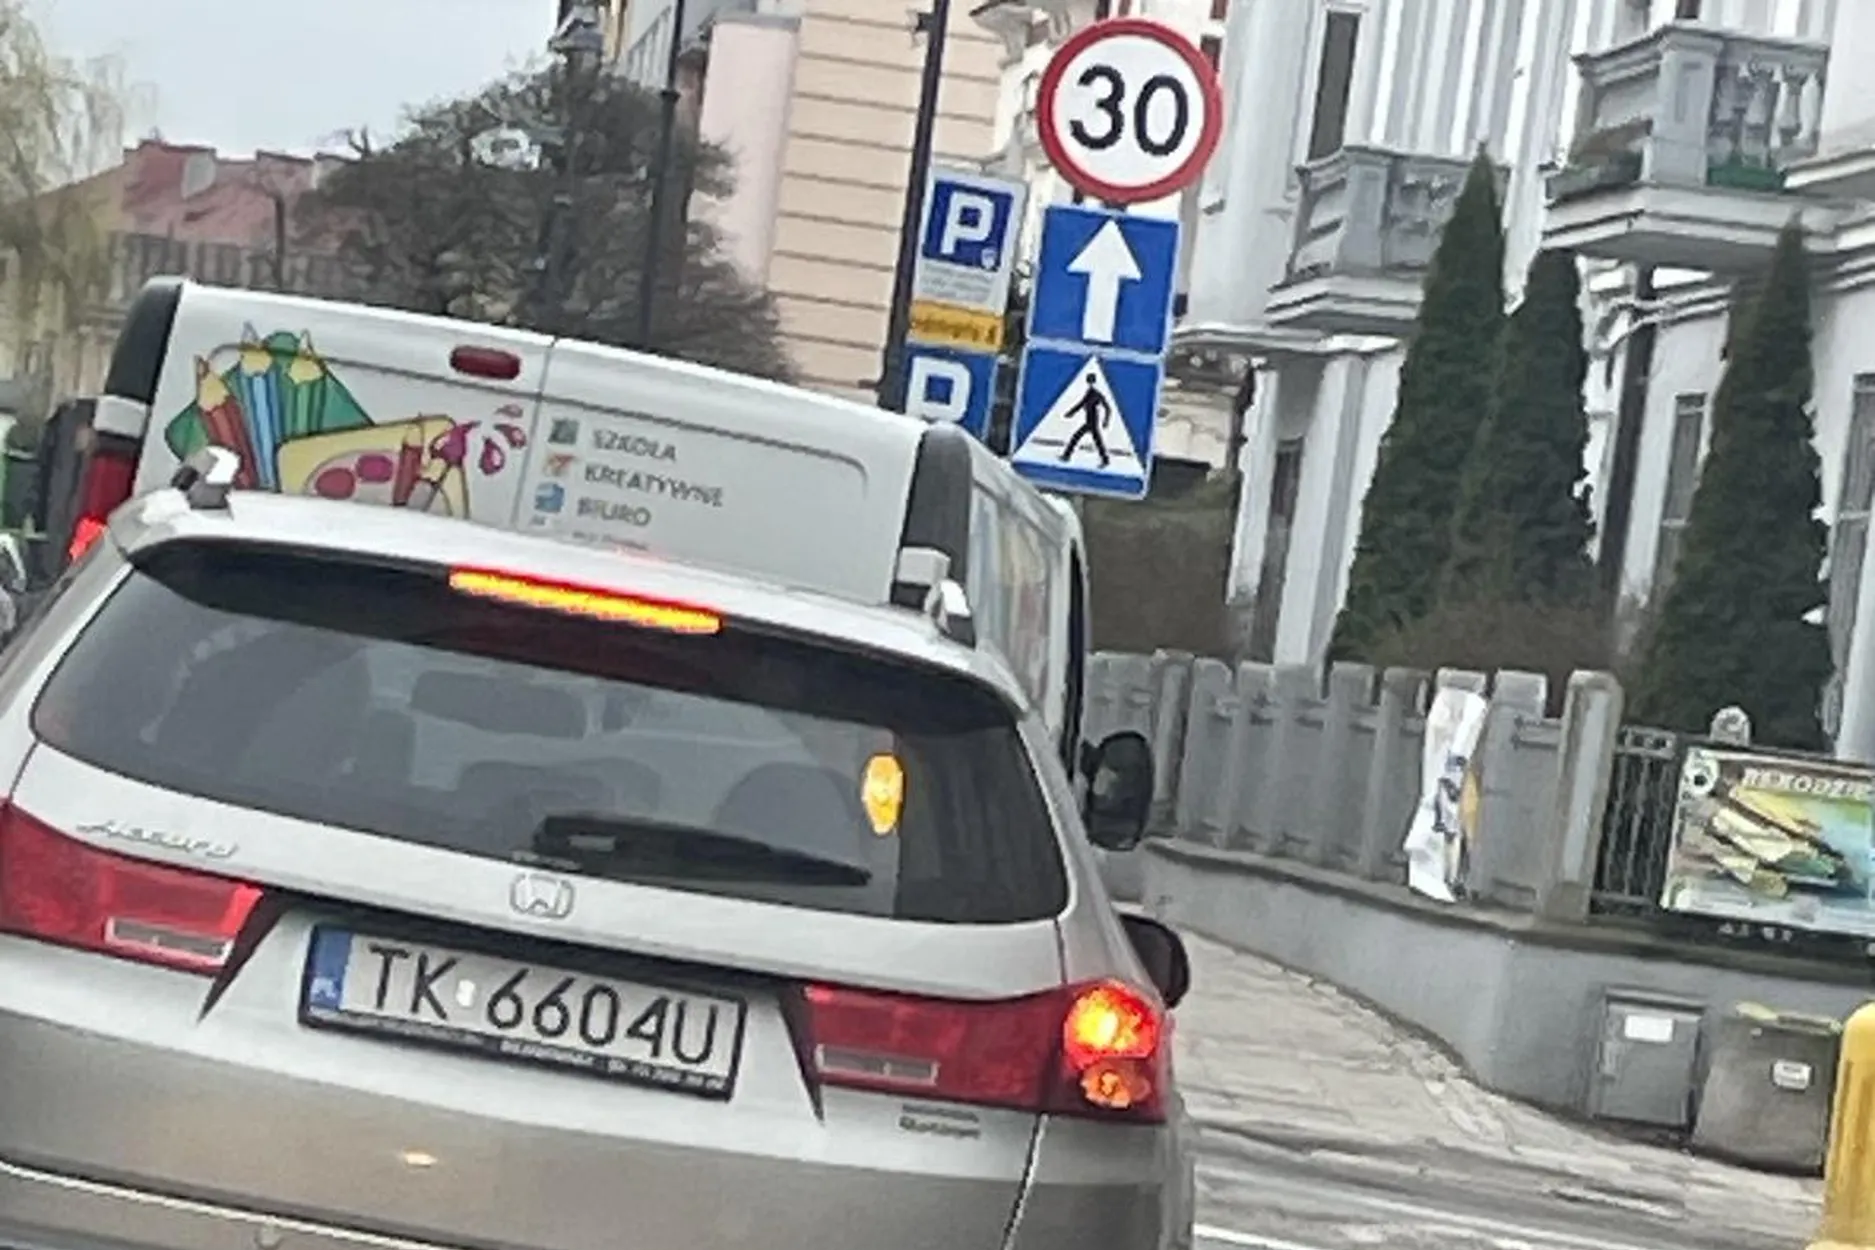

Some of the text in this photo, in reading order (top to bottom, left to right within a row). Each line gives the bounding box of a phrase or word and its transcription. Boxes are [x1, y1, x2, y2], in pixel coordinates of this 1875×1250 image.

[1069, 64, 1190, 157] 30
[940, 191, 996, 255] P
[906, 356, 973, 423] P
[368, 944, 458, 1021] TK
[486, 966, 719, 1065] 6604U
